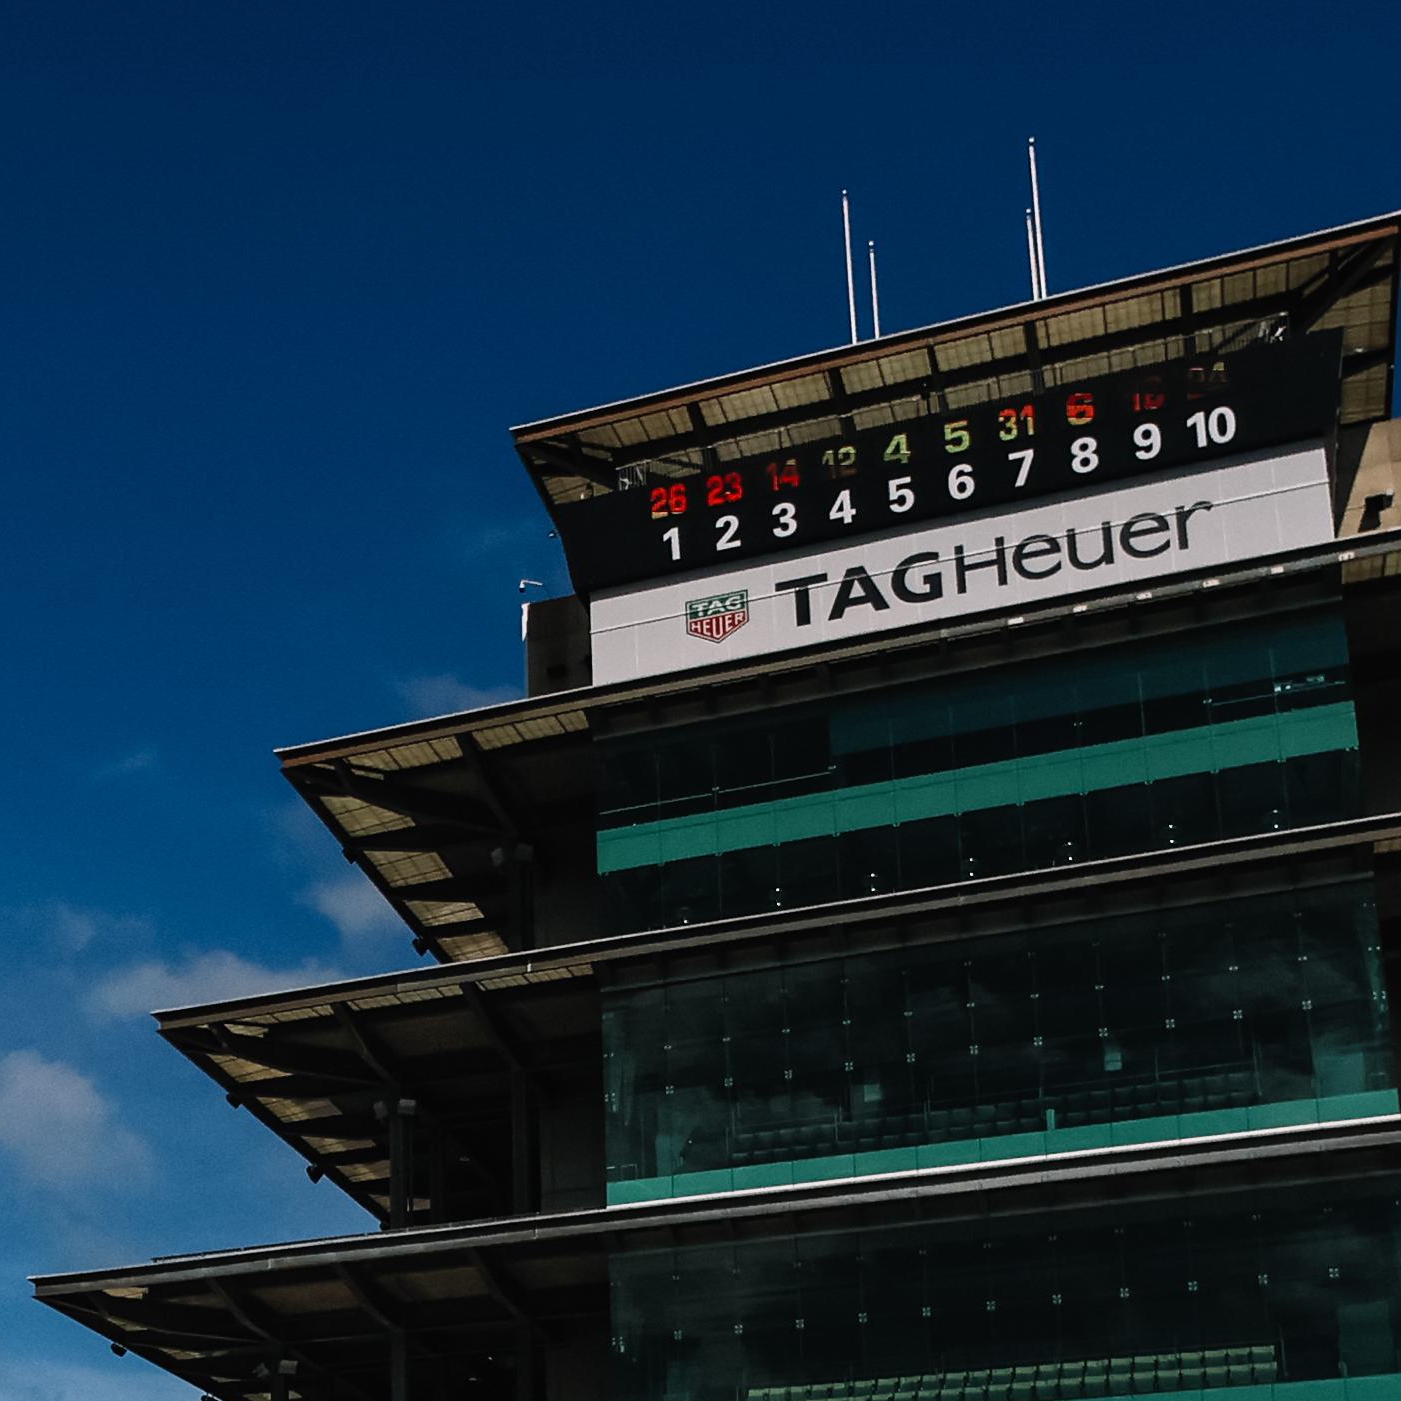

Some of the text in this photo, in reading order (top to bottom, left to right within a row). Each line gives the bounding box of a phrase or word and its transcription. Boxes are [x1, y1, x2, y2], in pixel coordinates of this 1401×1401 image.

[651, 484, 688, 519] 26
[706, 472, 743, 507] 23
[883, 434, 911, 465] 4
[944, 419, 971, 453] 5
[999, 404, 1035, 441] 31
[1066, 393, 1096, 425] 6
[662, 406, 1236, 561] 1 2 3 4 5 6 7 8 9 10
[691, 595, 742, 617] TAG
[691, 612, 744, 639] HEUER
